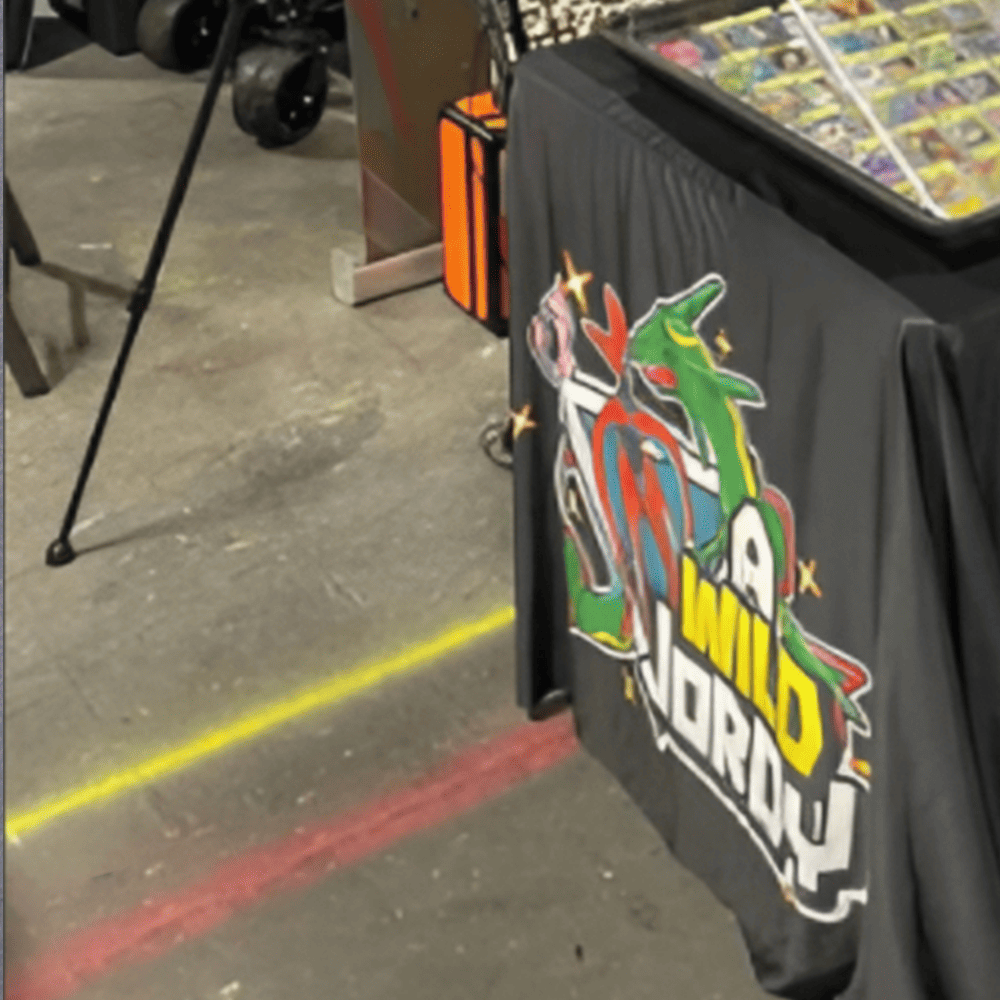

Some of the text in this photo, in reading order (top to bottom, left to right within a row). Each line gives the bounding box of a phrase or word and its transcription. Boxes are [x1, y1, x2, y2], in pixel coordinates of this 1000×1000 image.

[682, 553, 824, 777] WILD
[731, 501, 774, 627] A
[641, 600, 856, 892] JORDY
